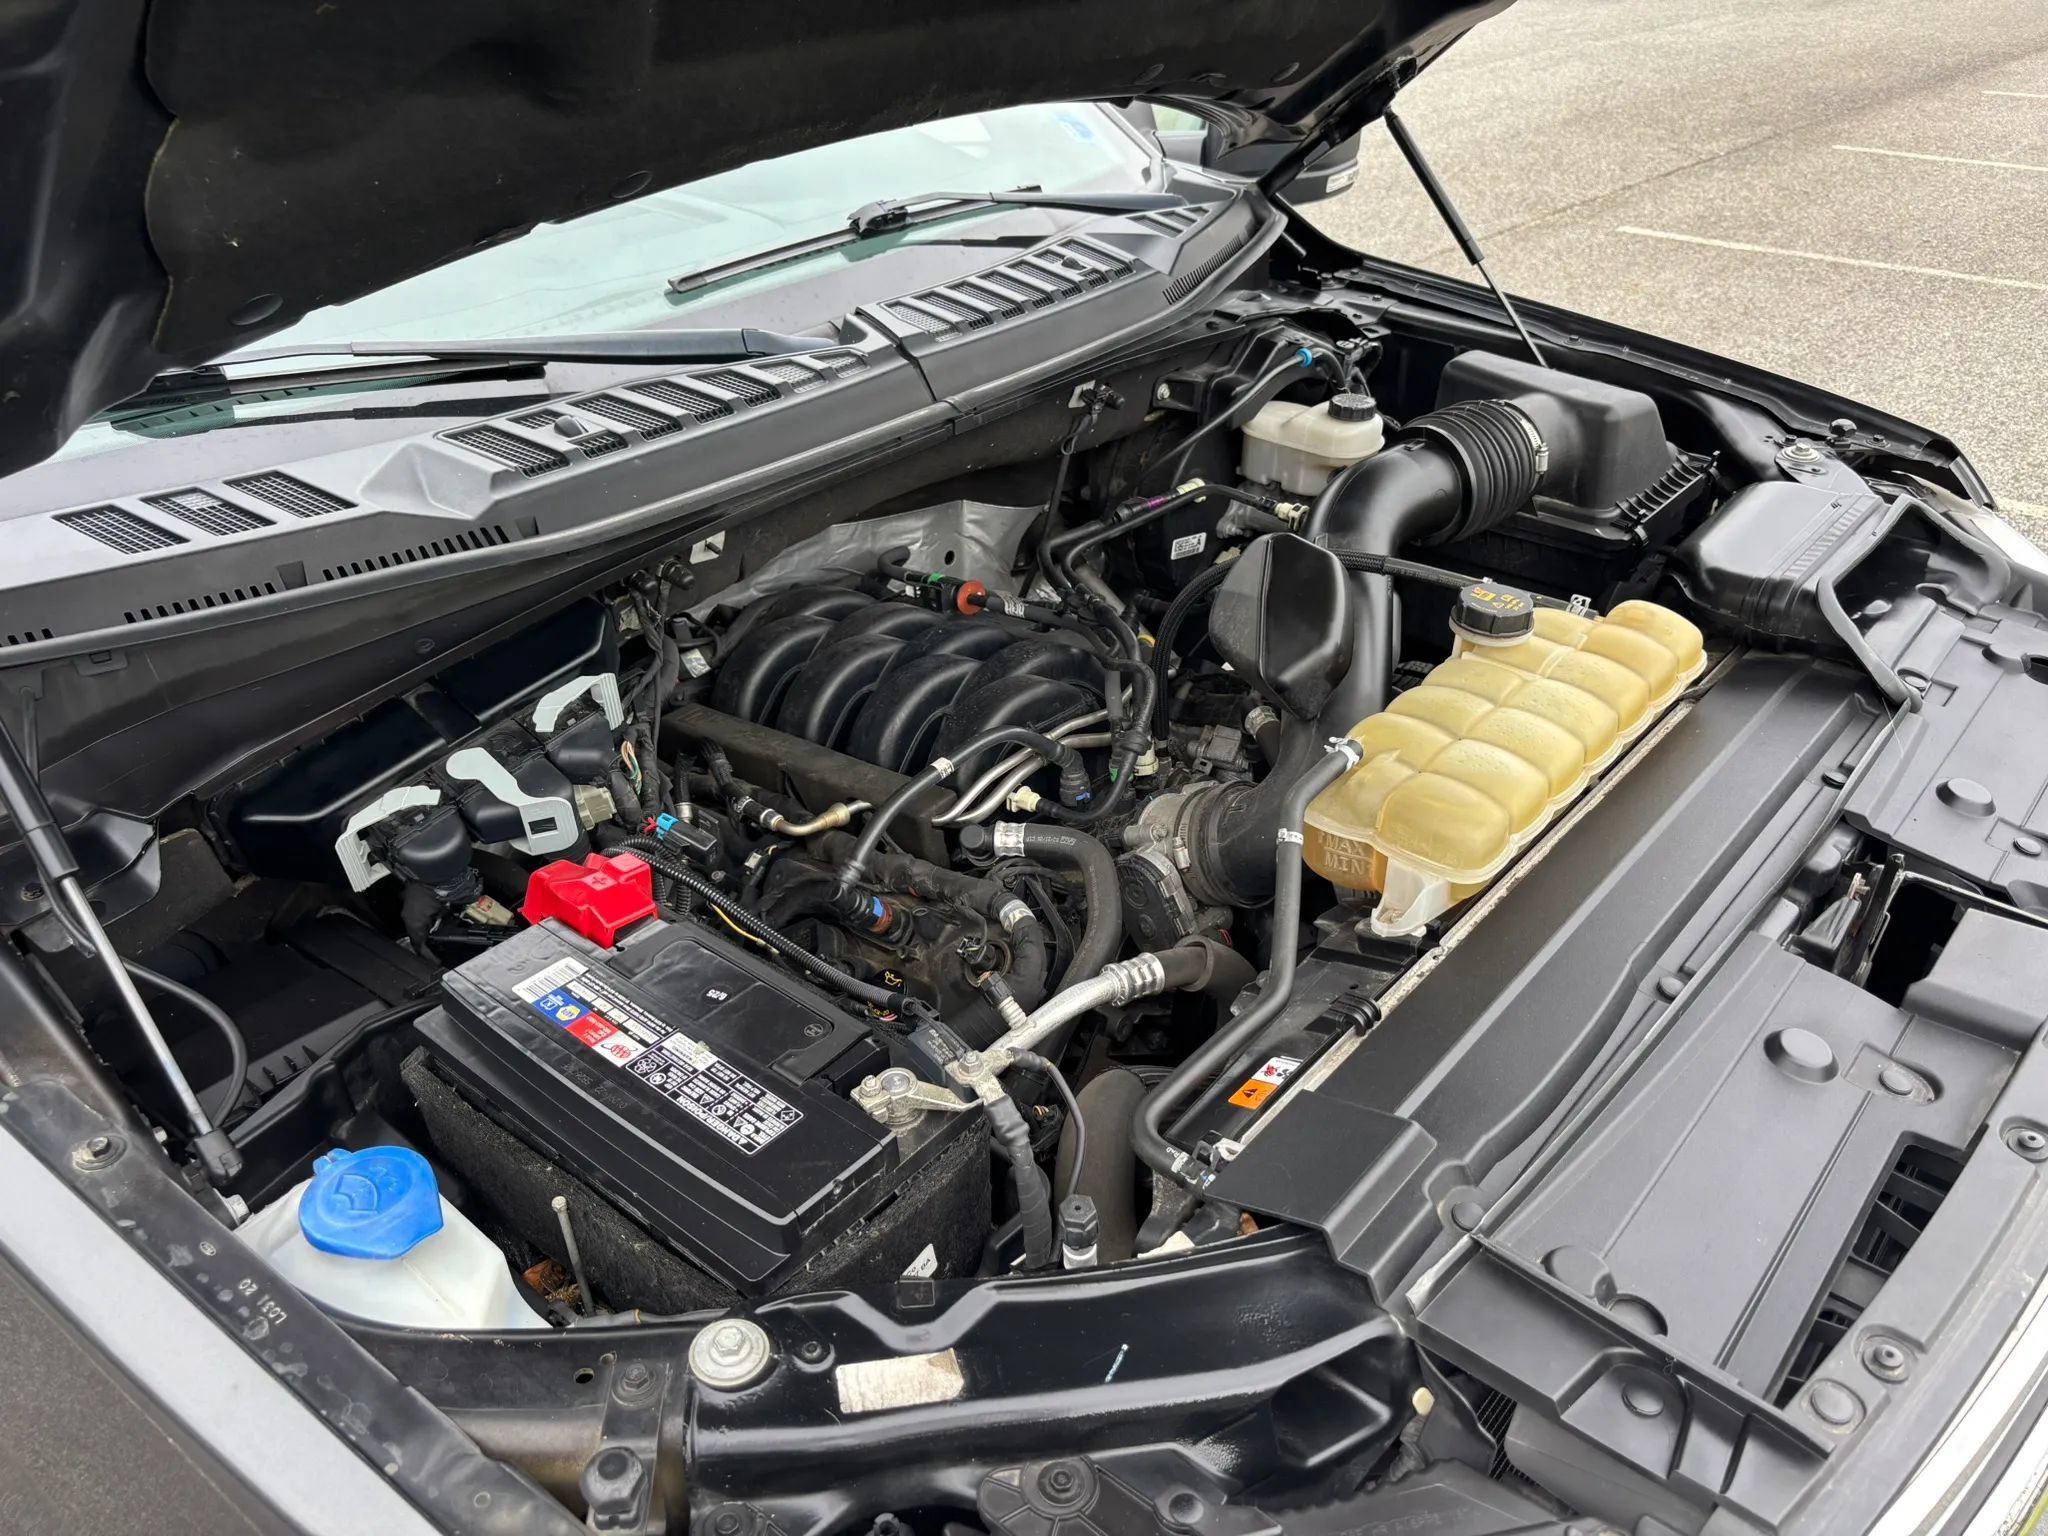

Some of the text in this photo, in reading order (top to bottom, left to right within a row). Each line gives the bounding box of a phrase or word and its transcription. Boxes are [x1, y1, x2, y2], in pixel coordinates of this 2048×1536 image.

[1326, 833, 1365, 857] MAX
[1325, 852, 1366, 875] MIN
[238, 1278, 260, 1296] 20
